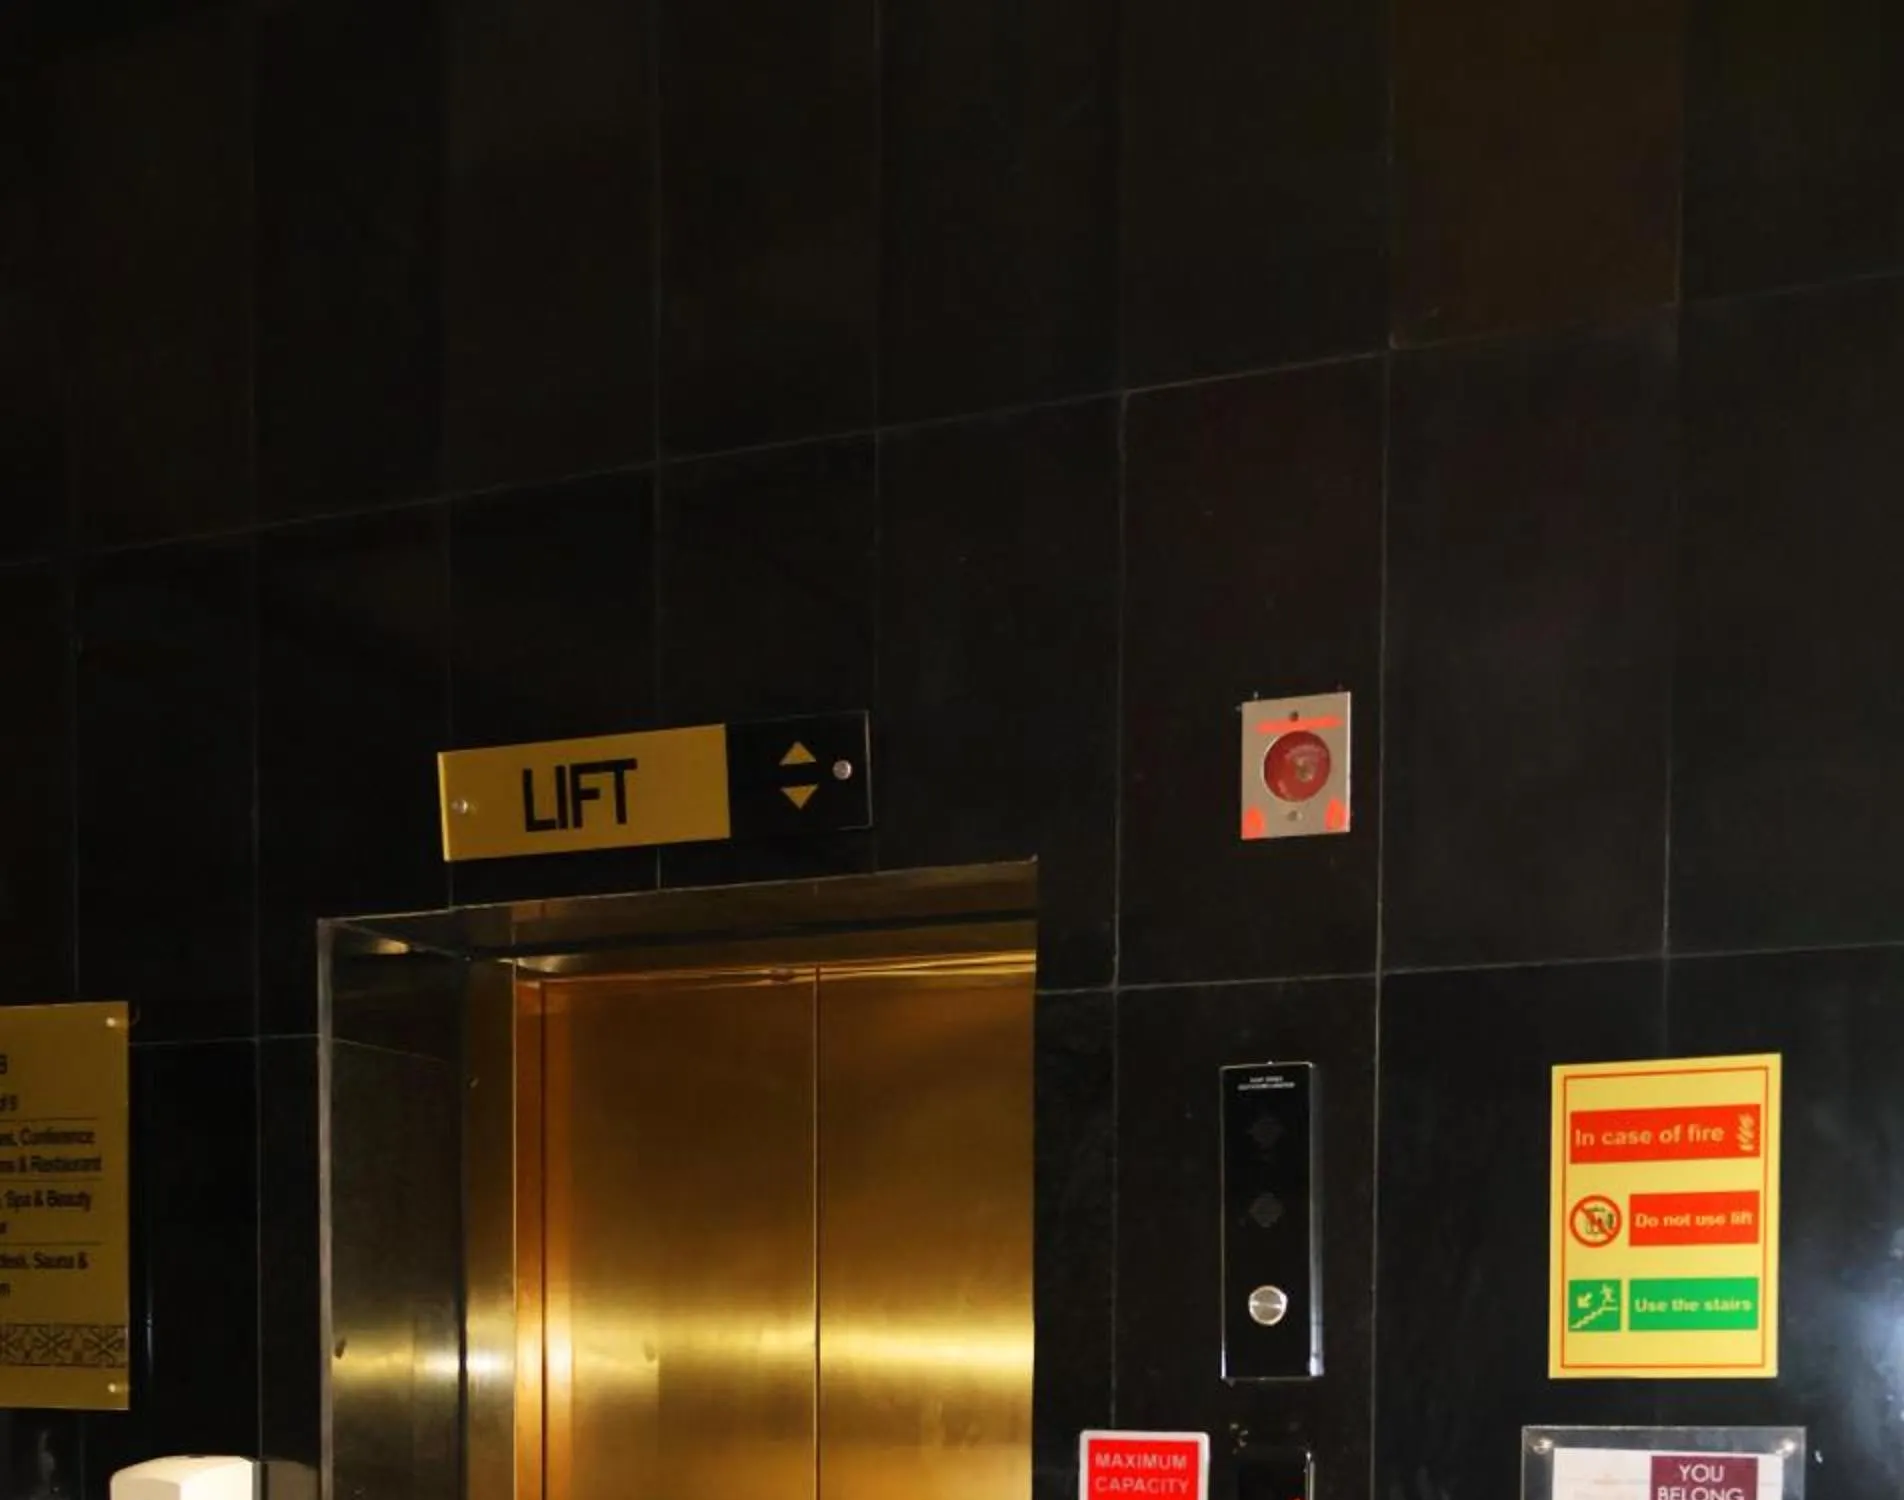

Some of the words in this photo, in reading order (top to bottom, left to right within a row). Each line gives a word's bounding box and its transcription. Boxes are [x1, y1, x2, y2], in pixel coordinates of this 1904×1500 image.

[523, 758, 638, 832] LIFT
[19, 1126, 96, 1145] Conference
[1575, 1129, 1595, 1147] In
[1601, 1130, 1653, 1145] case
[1660, 1124, 1682, 1143] of
[1688, 1123, 1725, 1142] fire
[31, 1151, 102, 1173] Restaurant
[47, 1189, 91, 1212] Beauty
[1635, 1213, 1658, 1228] Do
[1664, 1213, 1690, 1227] not
[1695, 1214, 1725, 1227] use
[1731, 1211, 1753, 1225] lift
[33, 1251, 74, 1270] Sauna
[1635, 1299, 1667, 1313] Use
[1671, 1299, 1698, 1312] the
[1703, 1299, 1753, 1312] stairs
[1095, 1452, 1187, 1470] MAXIMUM
[1679, 1464, 1725, 1483] YOU
[1095, 1475, 1189, 1495] CAPACITY
